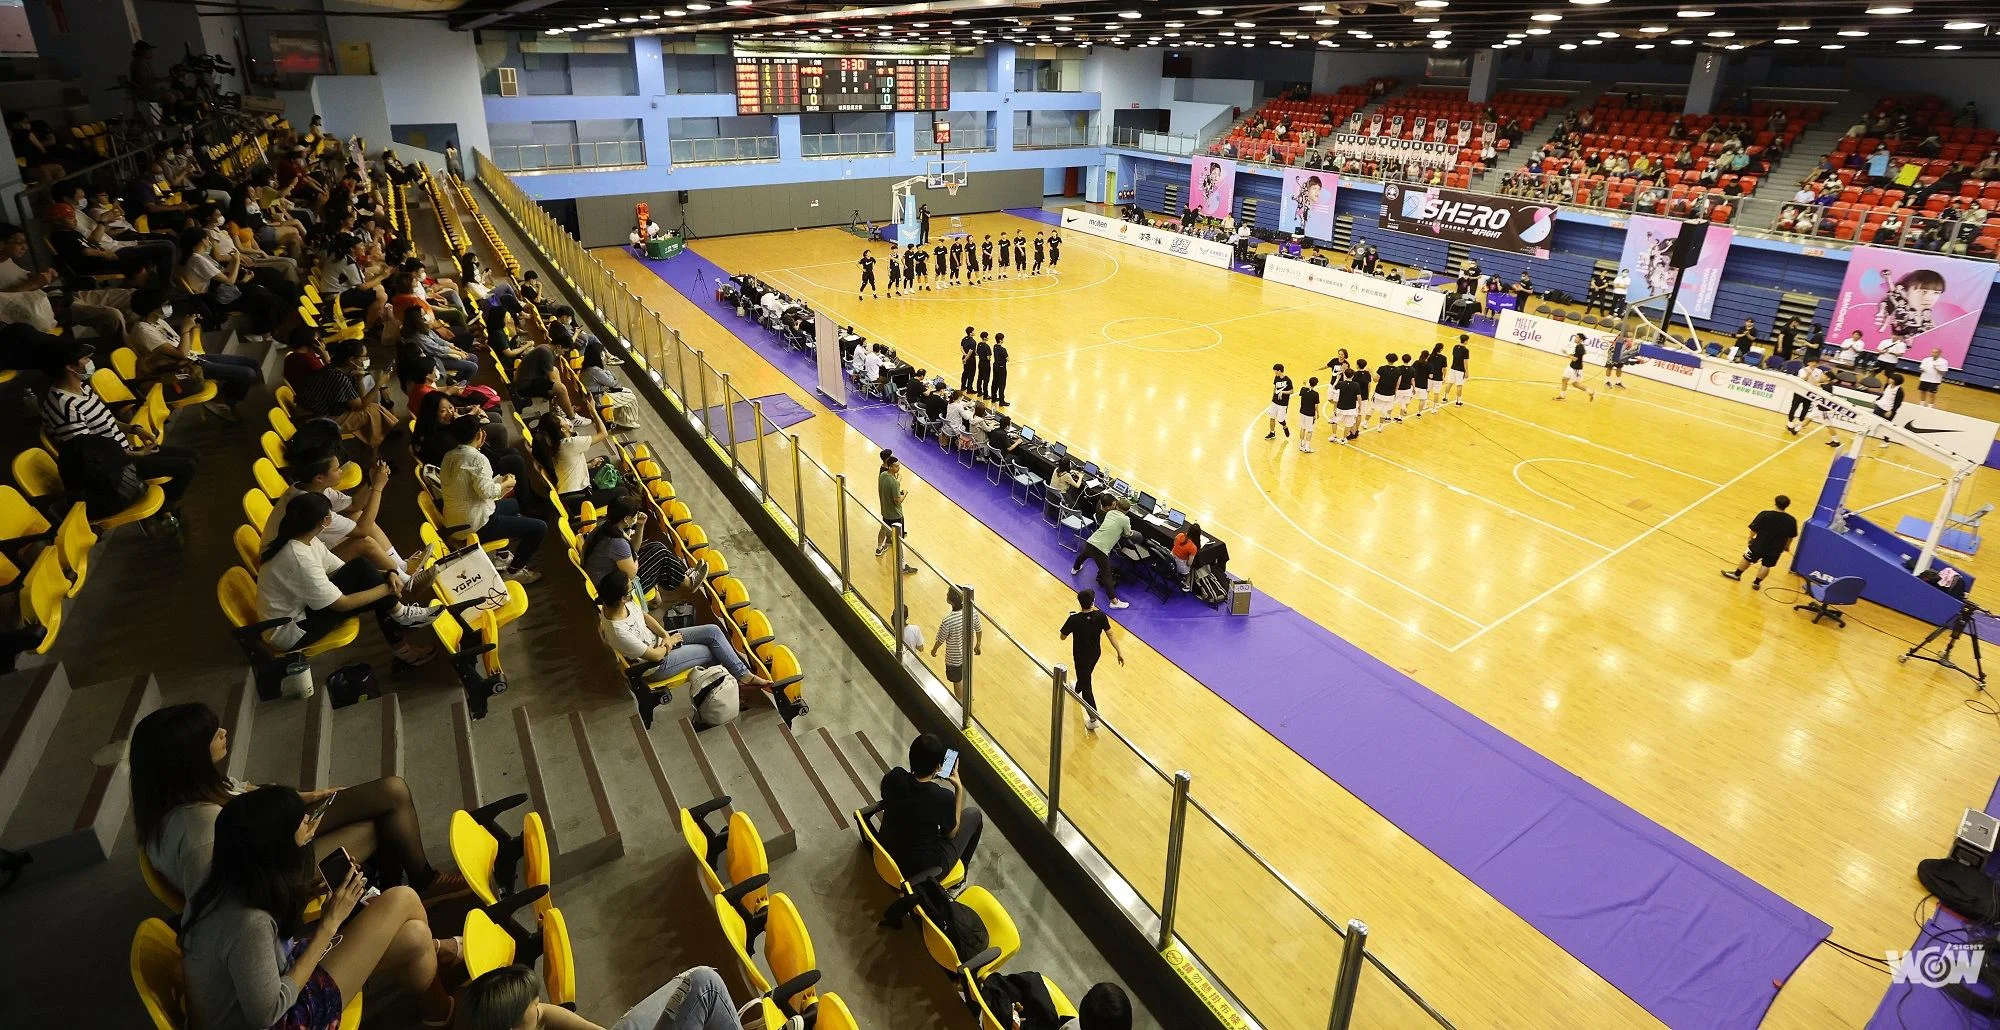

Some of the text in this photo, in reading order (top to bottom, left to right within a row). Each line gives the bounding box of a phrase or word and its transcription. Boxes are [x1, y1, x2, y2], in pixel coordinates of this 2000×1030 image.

[841, 59, 865, 70] 3:30
[813, 76, 820, 87] 0
[887, 77, 893, 87] 0
[810, 94, 817, 105] 0
[884, 94, 891, 104] 0
[936, 132, 950, 143] 24
[1423, 200, 1512, 230] SHERO
[1088, 218, 1108, 229] molten
[1833, 291, 1854, 332] TAIPOWER
[1512, 328, 1542, 343] agile
[1806, 390, 1858, 419] GARED
